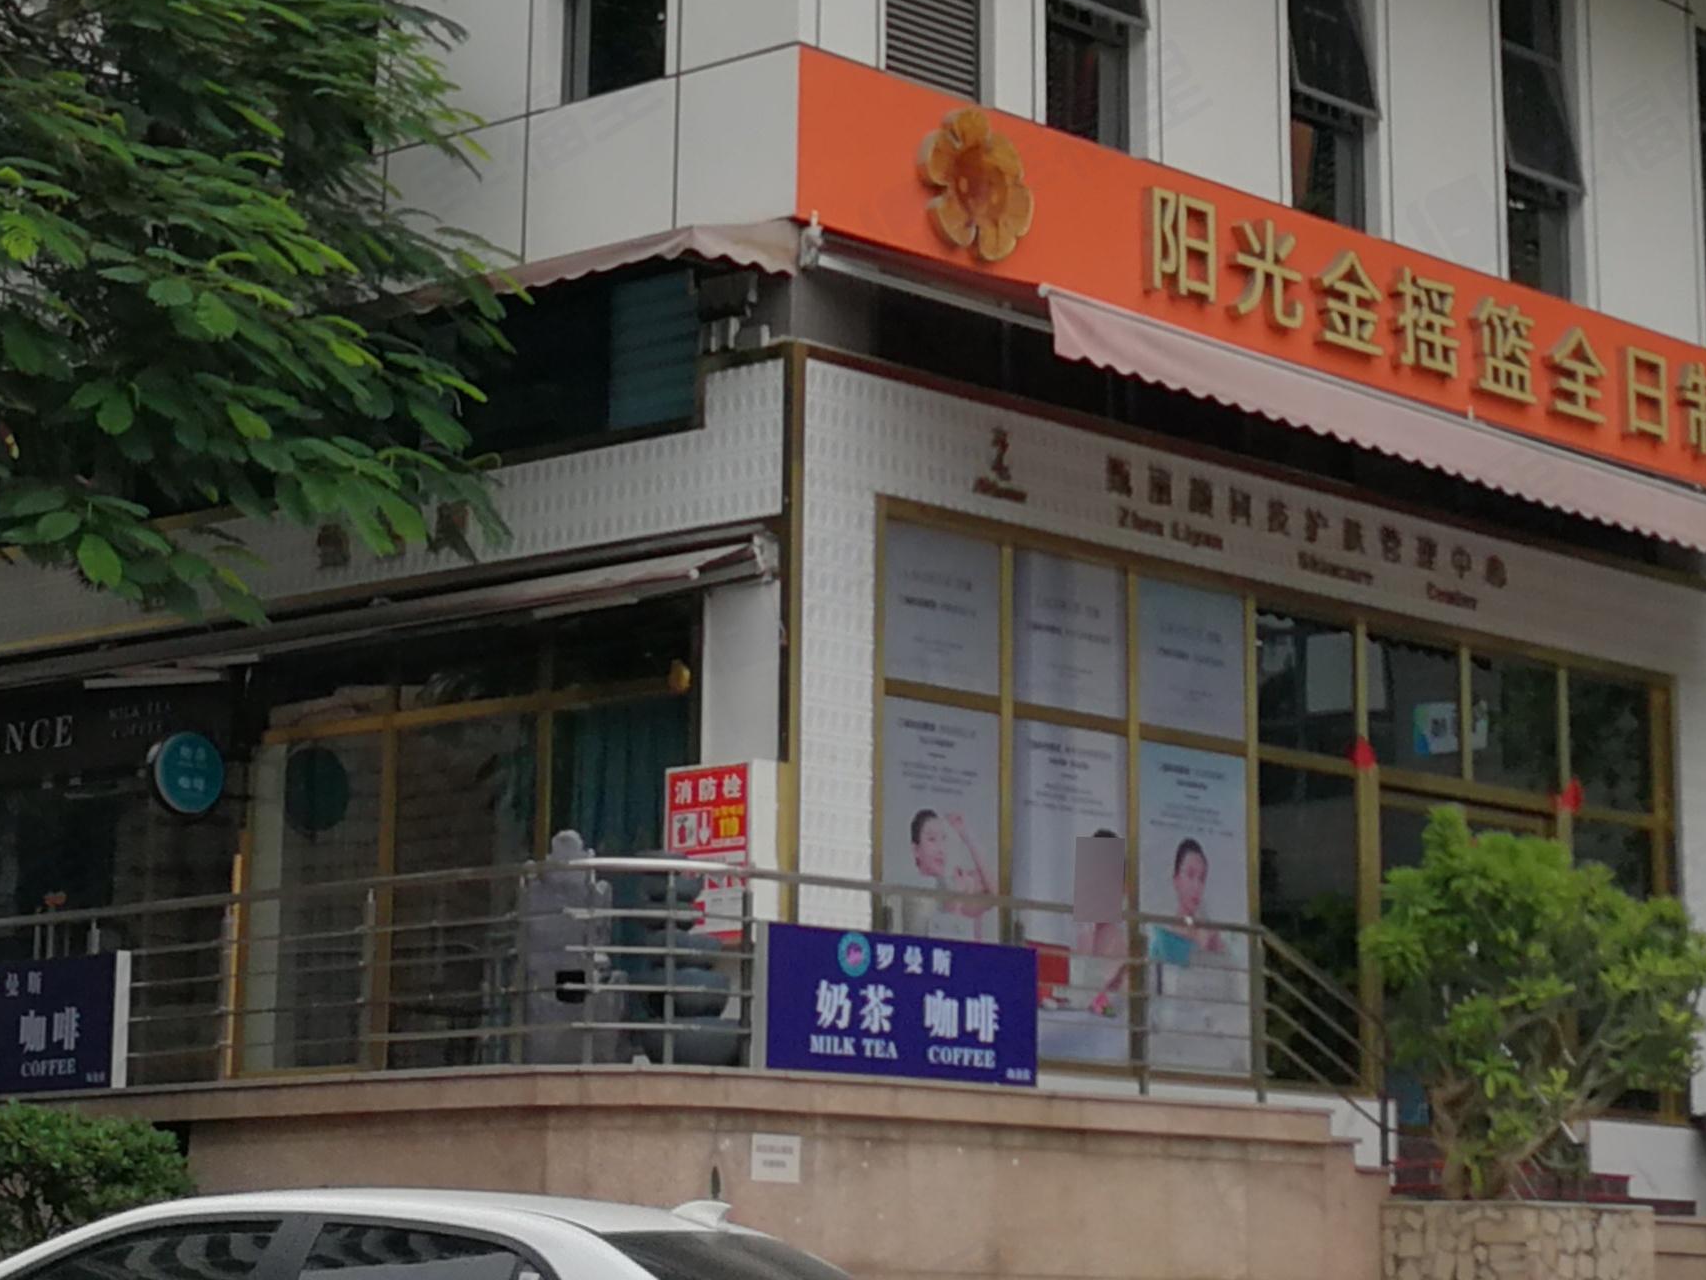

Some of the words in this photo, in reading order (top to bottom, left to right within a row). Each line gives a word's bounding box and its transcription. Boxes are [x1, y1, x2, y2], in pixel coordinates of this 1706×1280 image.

[674, 772, 743, 805] 消防栓
[874, 942, 954, 978] 罗曼斯
[815, 978, 896, 1035] 奶茶
[922, 988, 1000, 1043] 咖啡
[18, 1005, 81, 1054] 咖啡
[20, 1057, 77, 1079] COFFEE
[809, 1034, 857, 1056] MILK
[862, 1038, 899, 1060] TEA
[926, 1045, 997, 1069] COFFEE
